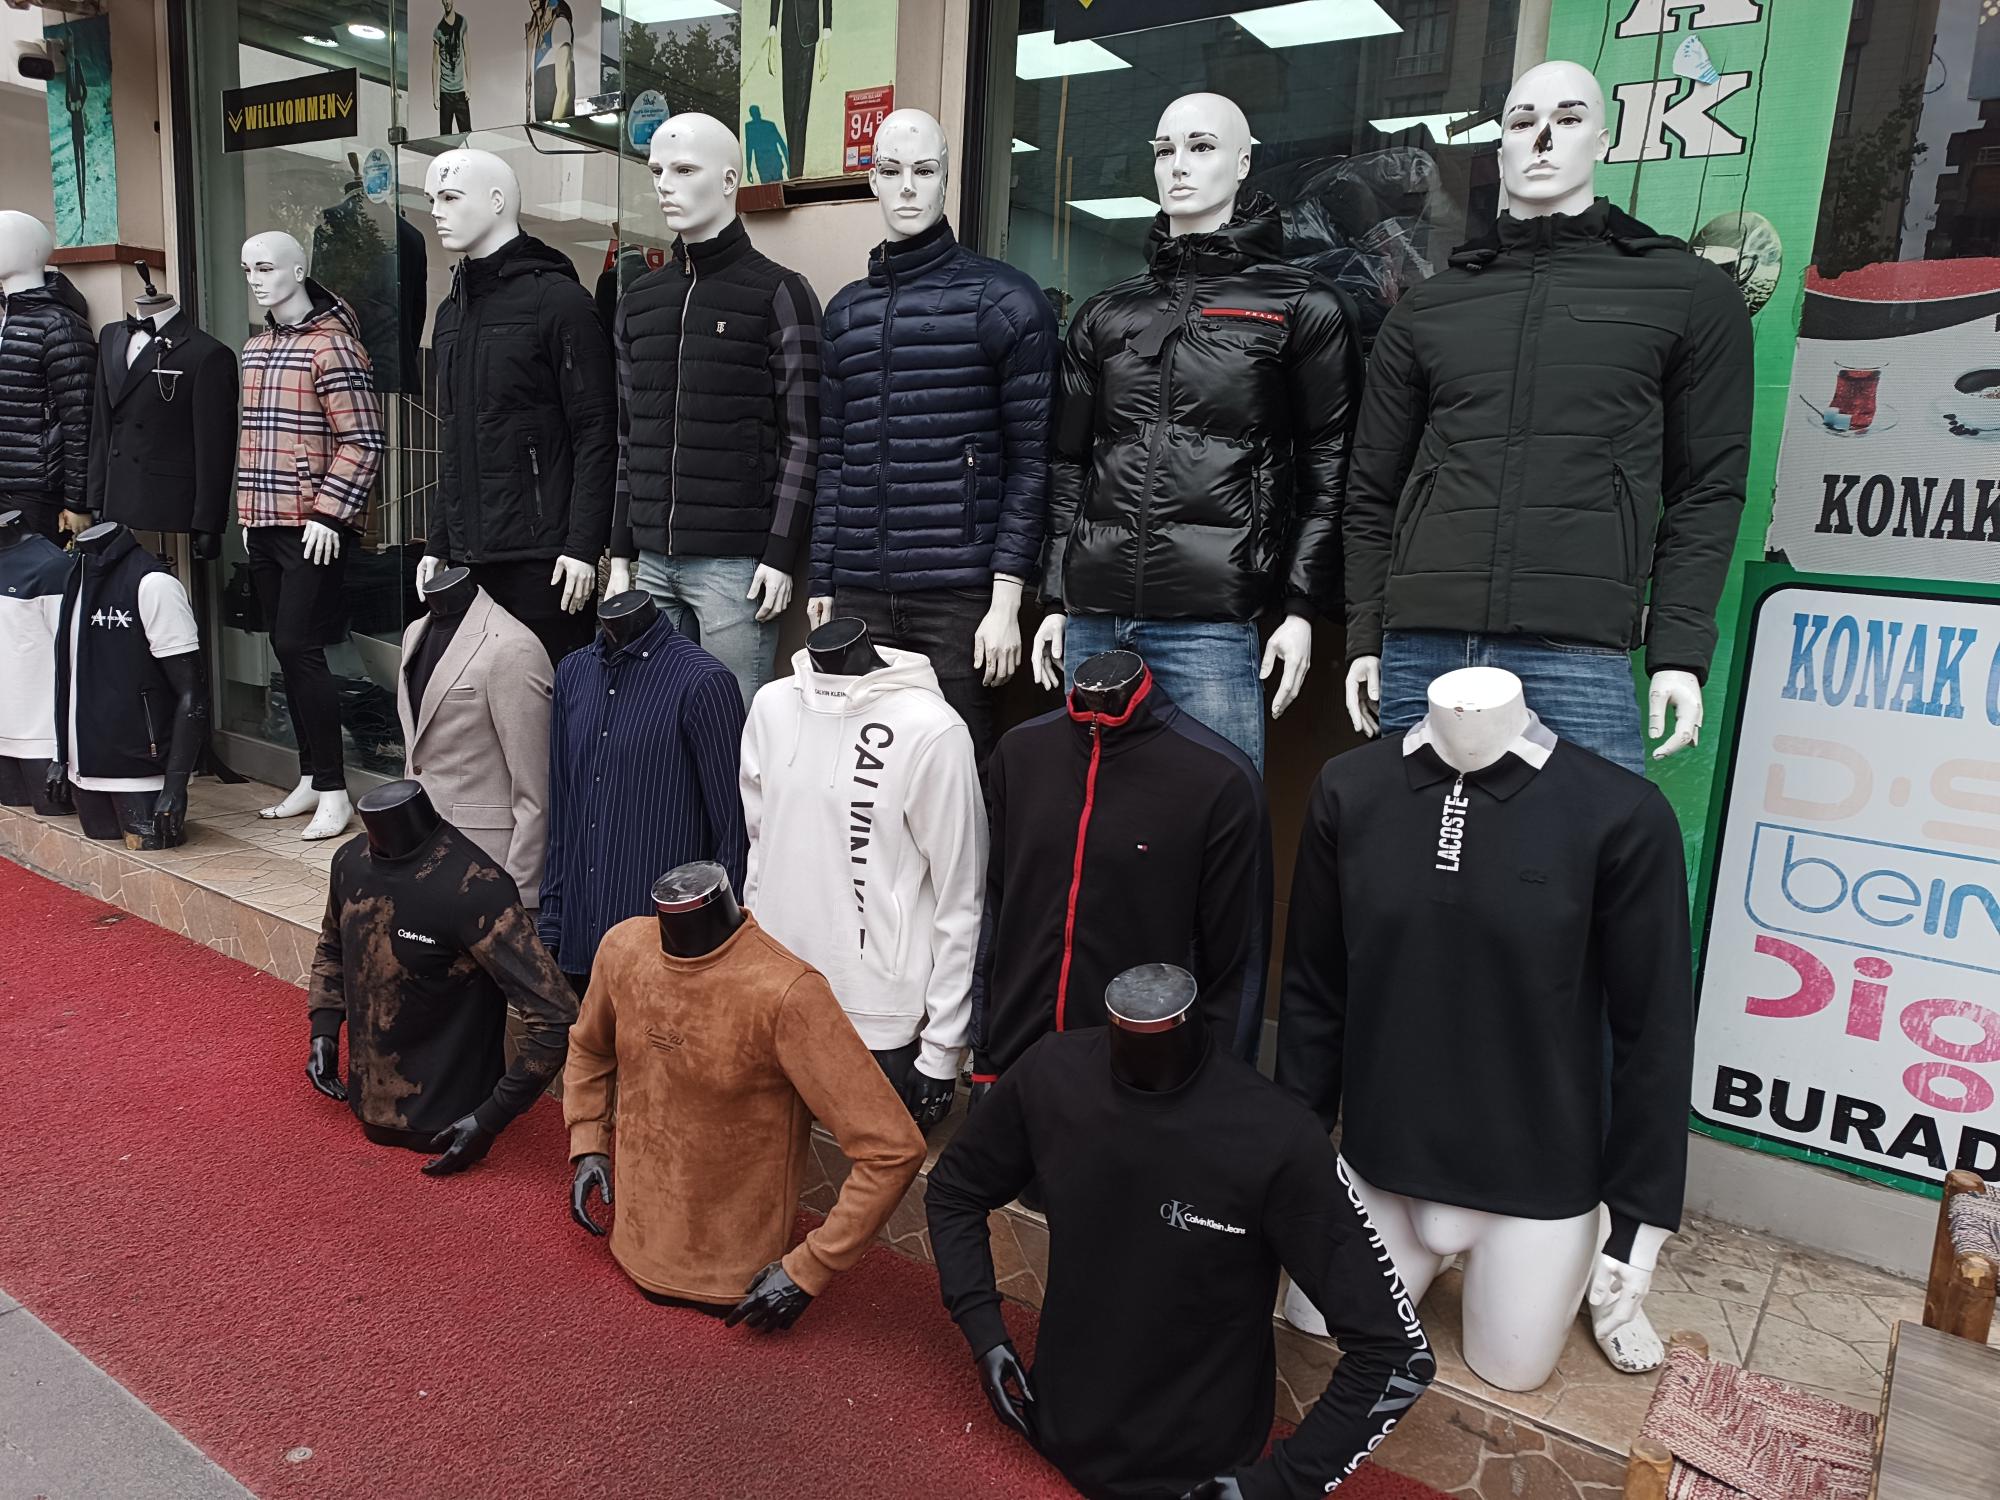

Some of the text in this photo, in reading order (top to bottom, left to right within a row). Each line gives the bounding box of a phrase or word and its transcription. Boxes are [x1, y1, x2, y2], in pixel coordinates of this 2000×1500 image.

[851, 112, 873, 140] 94
[1245, 311, 1279, 321] PRADA
[1814, 474, 2000, 542] KONAK
[1781, 612, 1978, 719] KONAK
[1435, 794, 1469, 872] LACOSTE
[397, 928, 418, 940] Calvin
[1184, 1213, 1206, 1226] Calvin
[1207, 1218, 1224, 1231] Klein
[1224, 1224, 1246, 1234] Jeans
